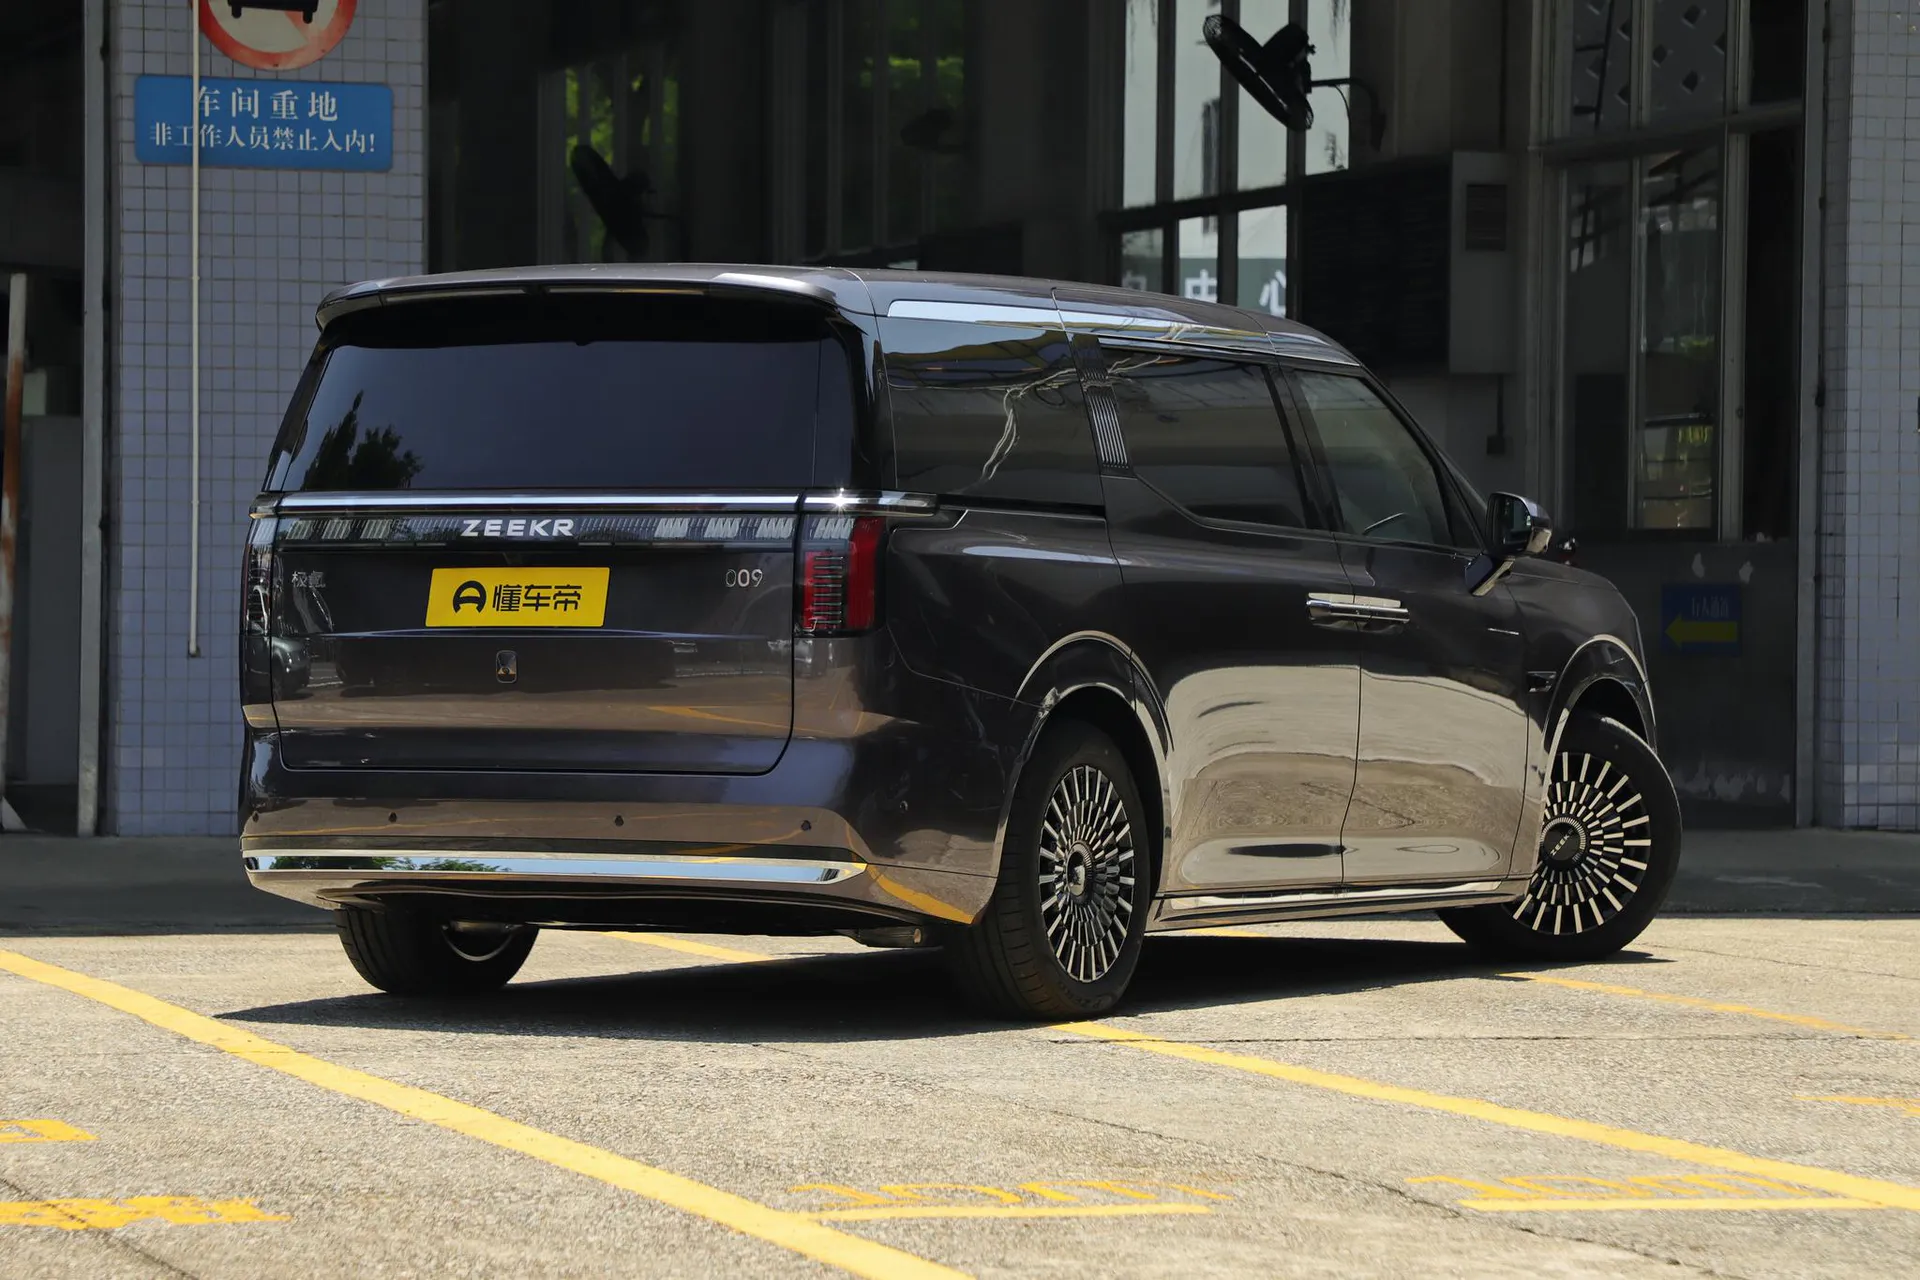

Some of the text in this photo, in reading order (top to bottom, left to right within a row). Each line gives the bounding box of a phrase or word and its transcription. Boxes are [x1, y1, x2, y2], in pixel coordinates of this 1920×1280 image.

[198, 85, 338, 122] 车间重地
[460, 518, 574, 537] ZEEKR
[725, 568, 763, 588] 009
[492, 584, 583, 612] 懂车帝
